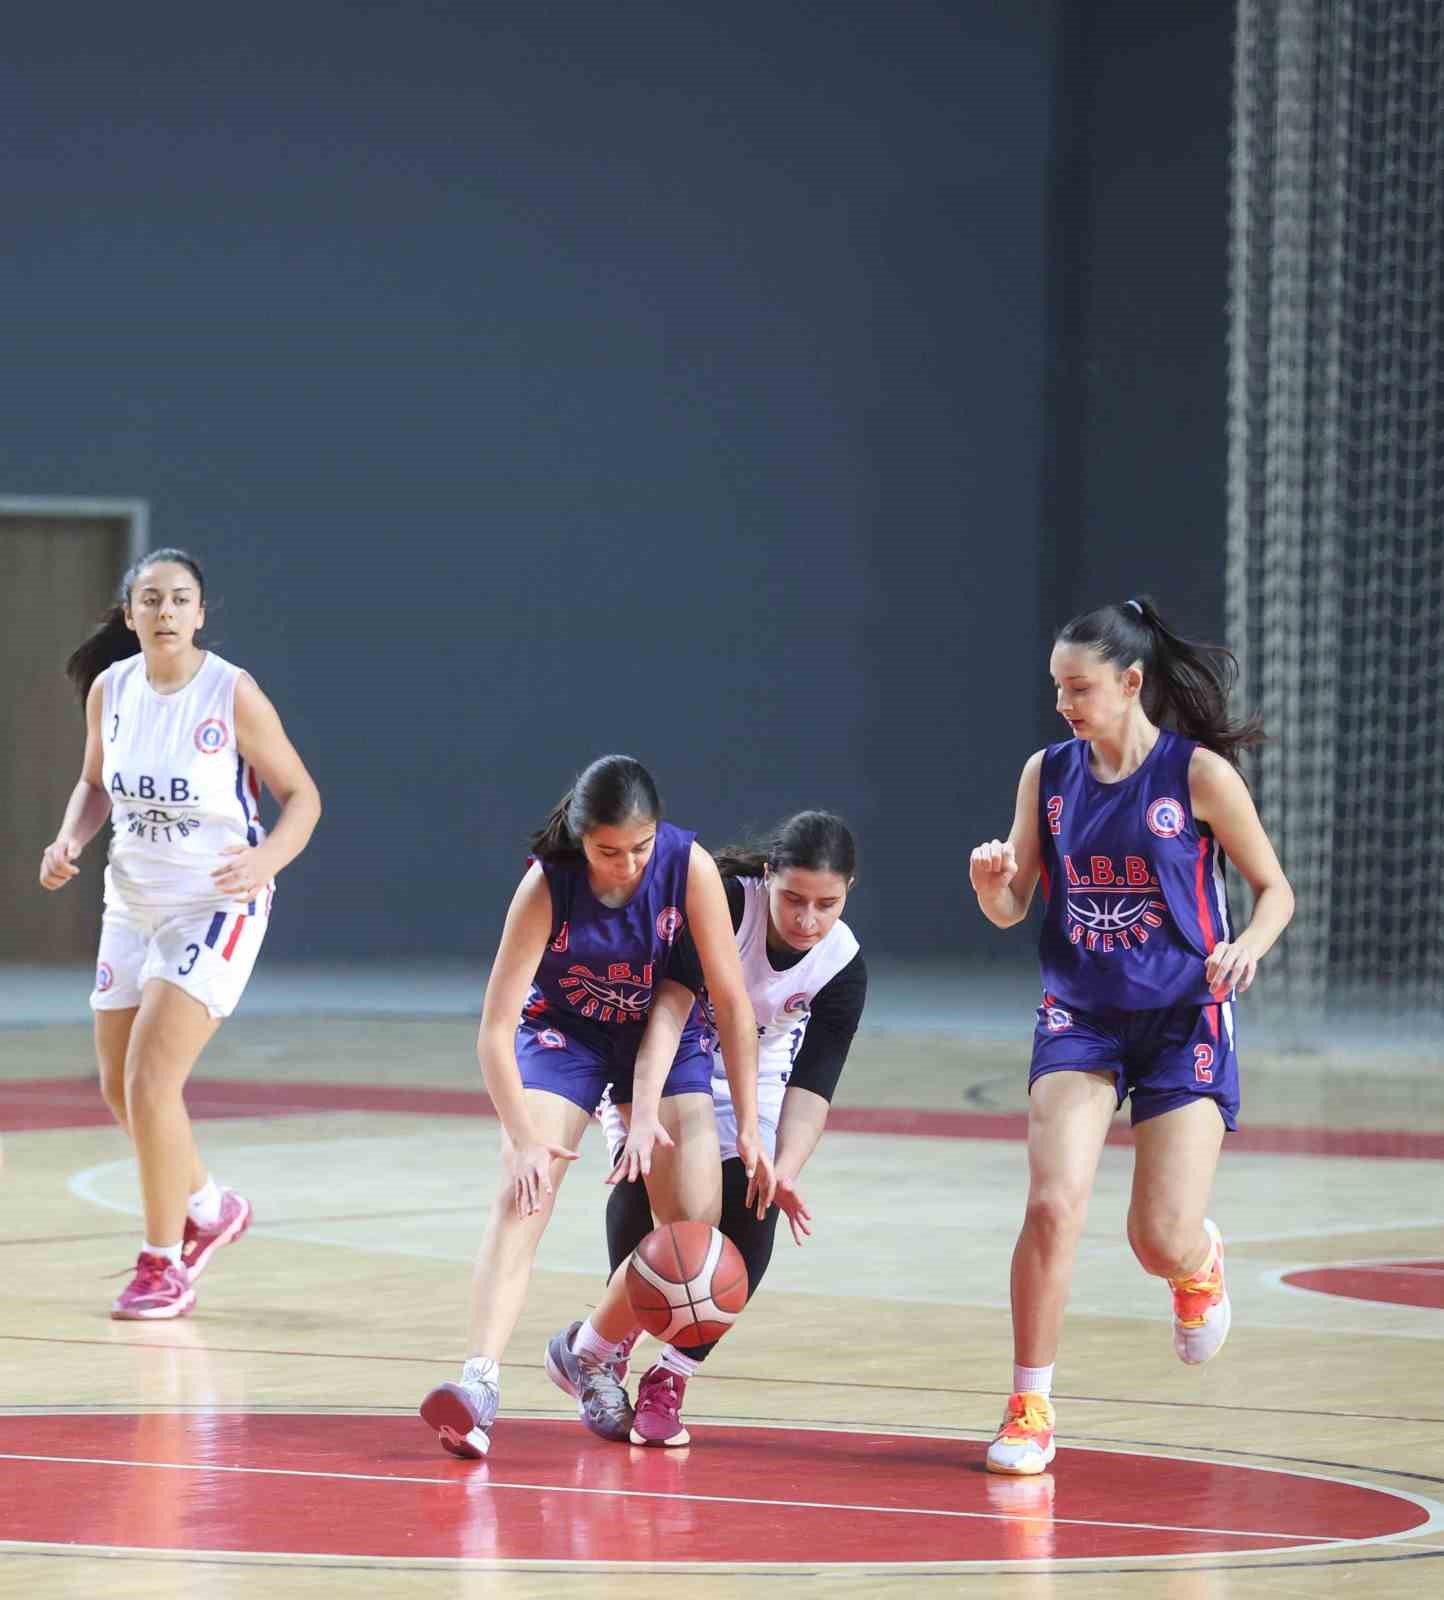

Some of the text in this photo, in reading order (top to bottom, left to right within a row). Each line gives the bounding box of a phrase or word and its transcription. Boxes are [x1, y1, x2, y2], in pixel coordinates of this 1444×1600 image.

[111, 772, 199, 802] A.B.B.
[1047, 795, 1064, 835] 2
[1064, 899, 1169, 953] SKETBO
[178, 943, 200, 976] 3
[1194, 1043, 1215, 1084] 2
